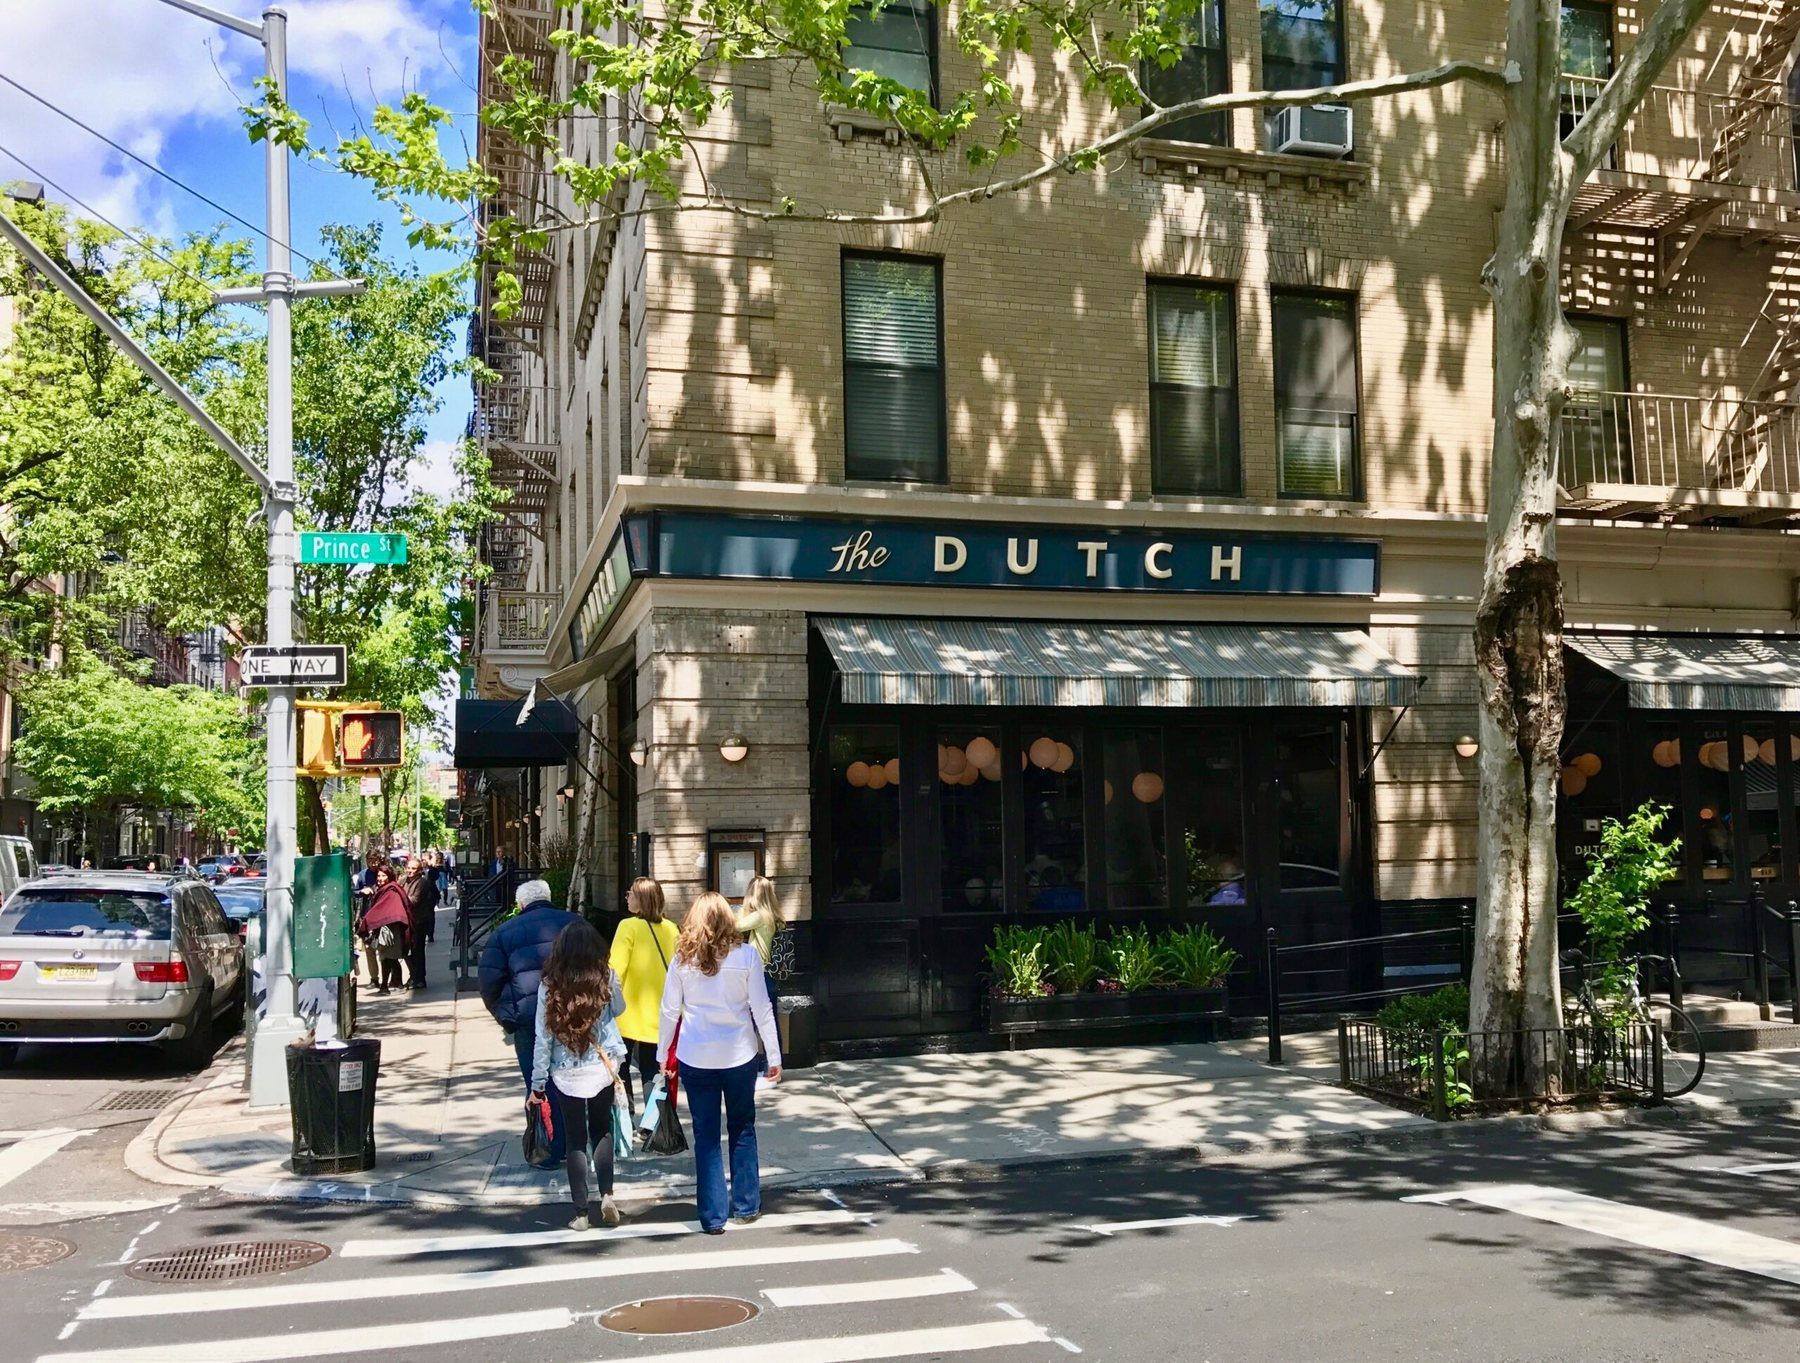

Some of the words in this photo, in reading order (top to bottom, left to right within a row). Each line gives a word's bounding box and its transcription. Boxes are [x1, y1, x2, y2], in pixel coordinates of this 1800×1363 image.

[313, 537, 370, 559] Prince
[379, 538, 391, 552] St
[826, 530, 891, 572] the
[934, 536, 1242, 581] DUTCH
[241, 659, 270, 675] ONE
[290, 658, 328, 673] WAY
[1575, 844, 1612, 855] DUTC
